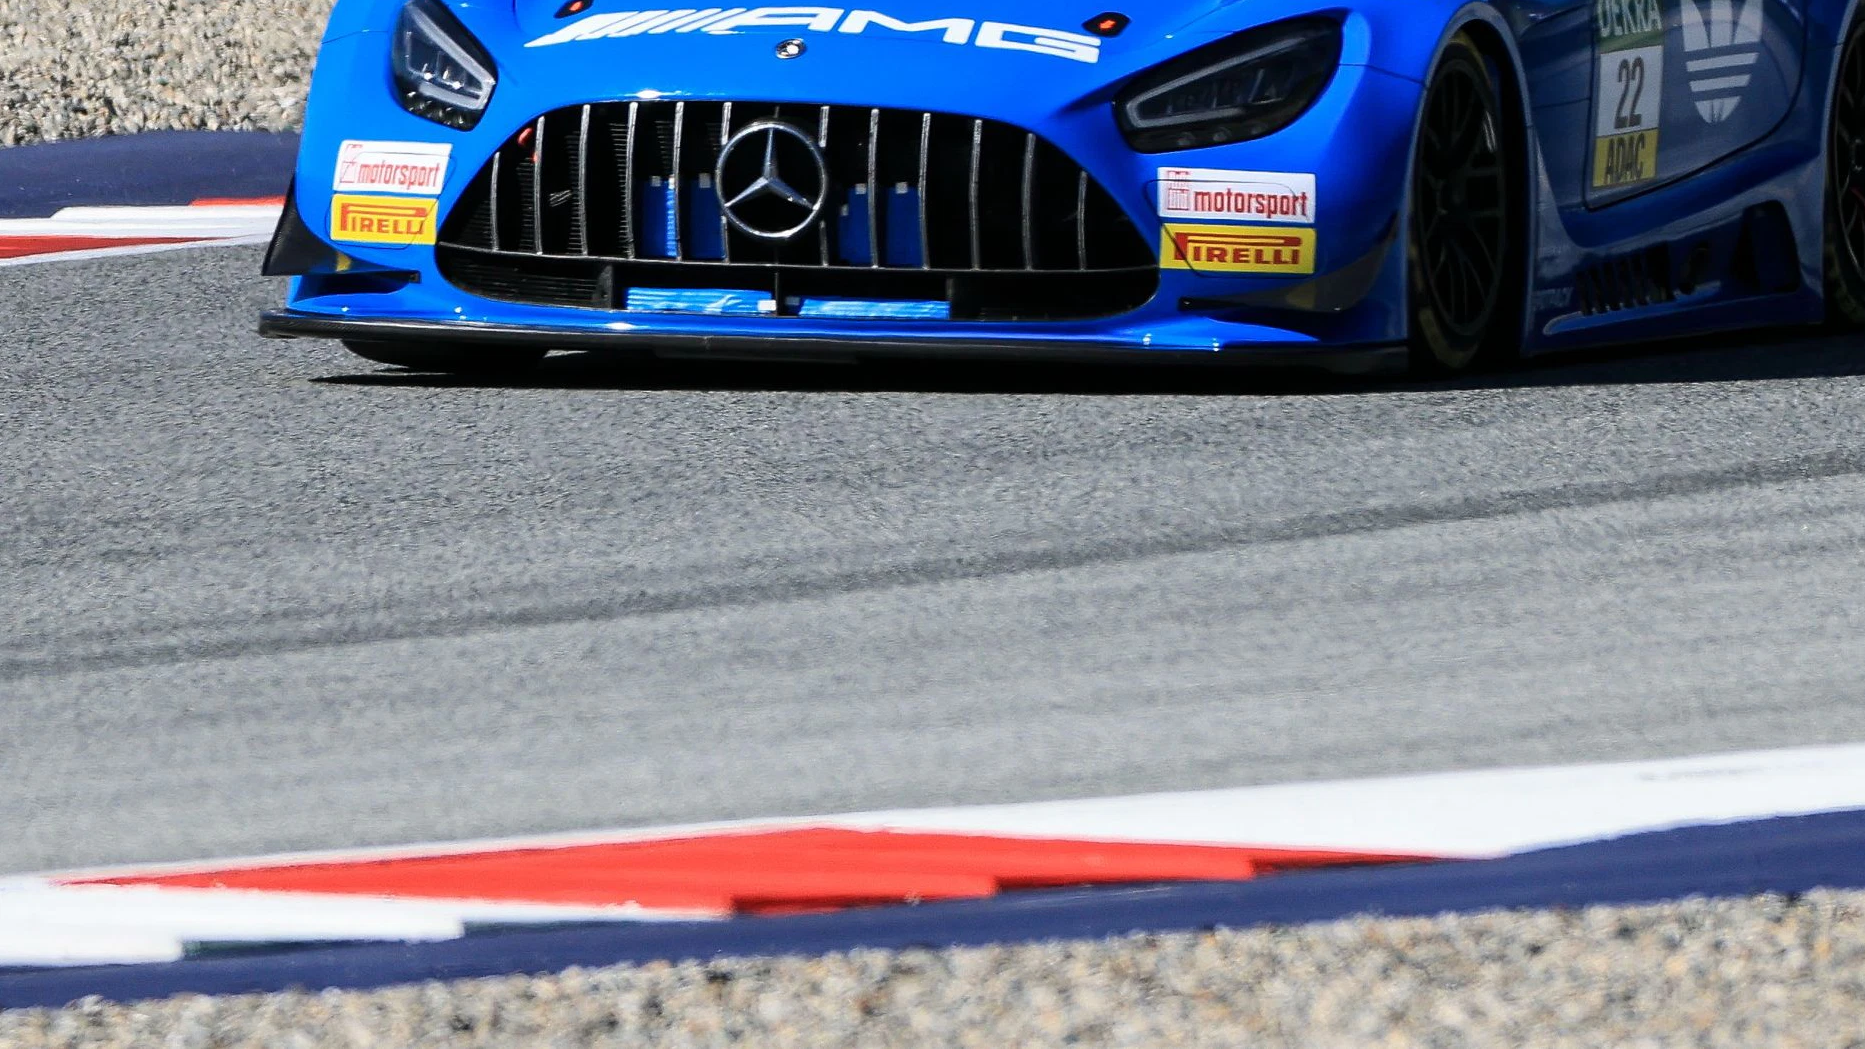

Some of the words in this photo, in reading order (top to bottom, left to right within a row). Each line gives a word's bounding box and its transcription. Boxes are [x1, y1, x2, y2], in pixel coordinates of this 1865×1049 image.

[704, 6, 1102, 63] AMG
[1614, 56, 1645, 130] 22
[357, 160, 440, 191] motorsport
[1605, 133, 1646, 185] ADAC
[340, 202, 427, 235] PIRELLI
[1194, 187, 1308, 218] motorsport
[1174, 232, 1302, 265] PIRELLI
